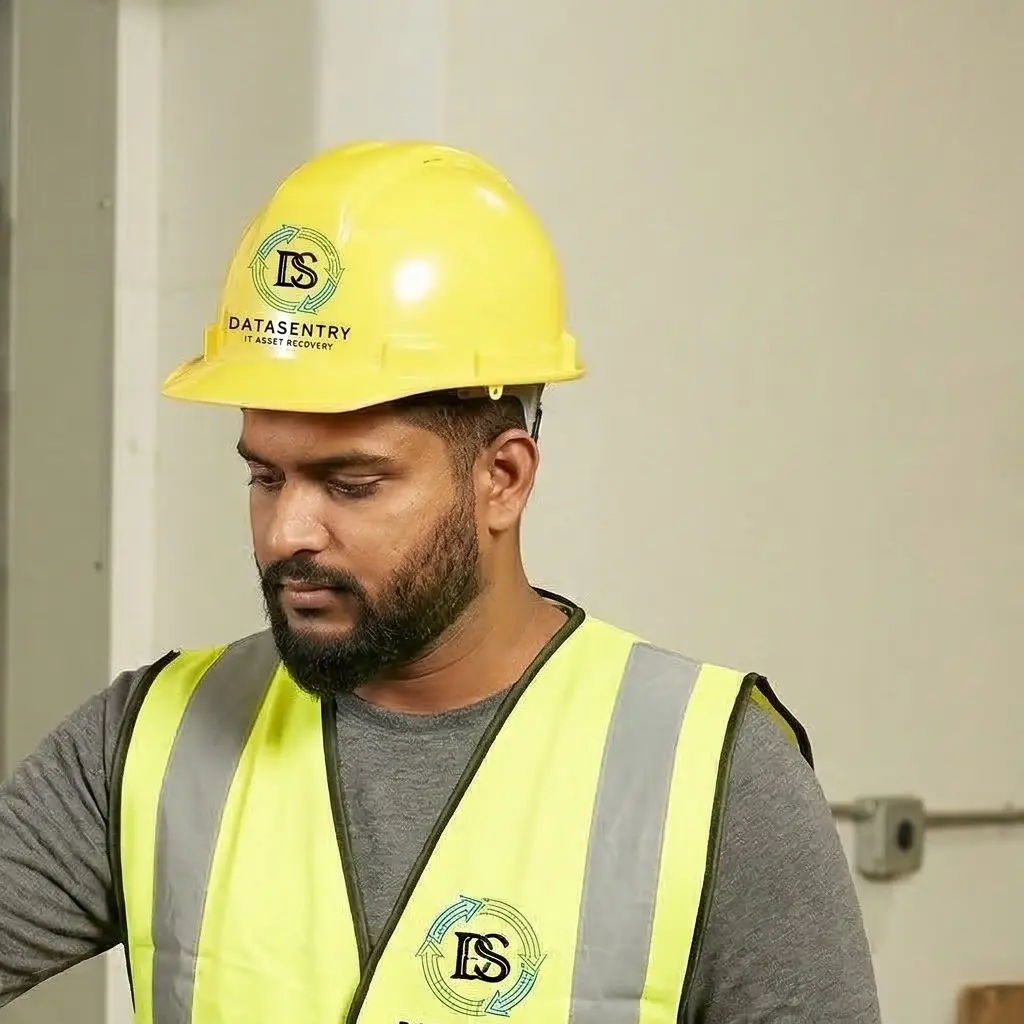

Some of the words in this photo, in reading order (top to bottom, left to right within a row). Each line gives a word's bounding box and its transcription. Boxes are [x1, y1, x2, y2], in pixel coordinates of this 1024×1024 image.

[273, 250, 318, 289] DS
[229, 316, 351, 341] DATASENTRY
[256, 337, 283, 346] ASSET
[287, 339, 334, 350] RECOVERY
[450, 932, 510, 983] DS
